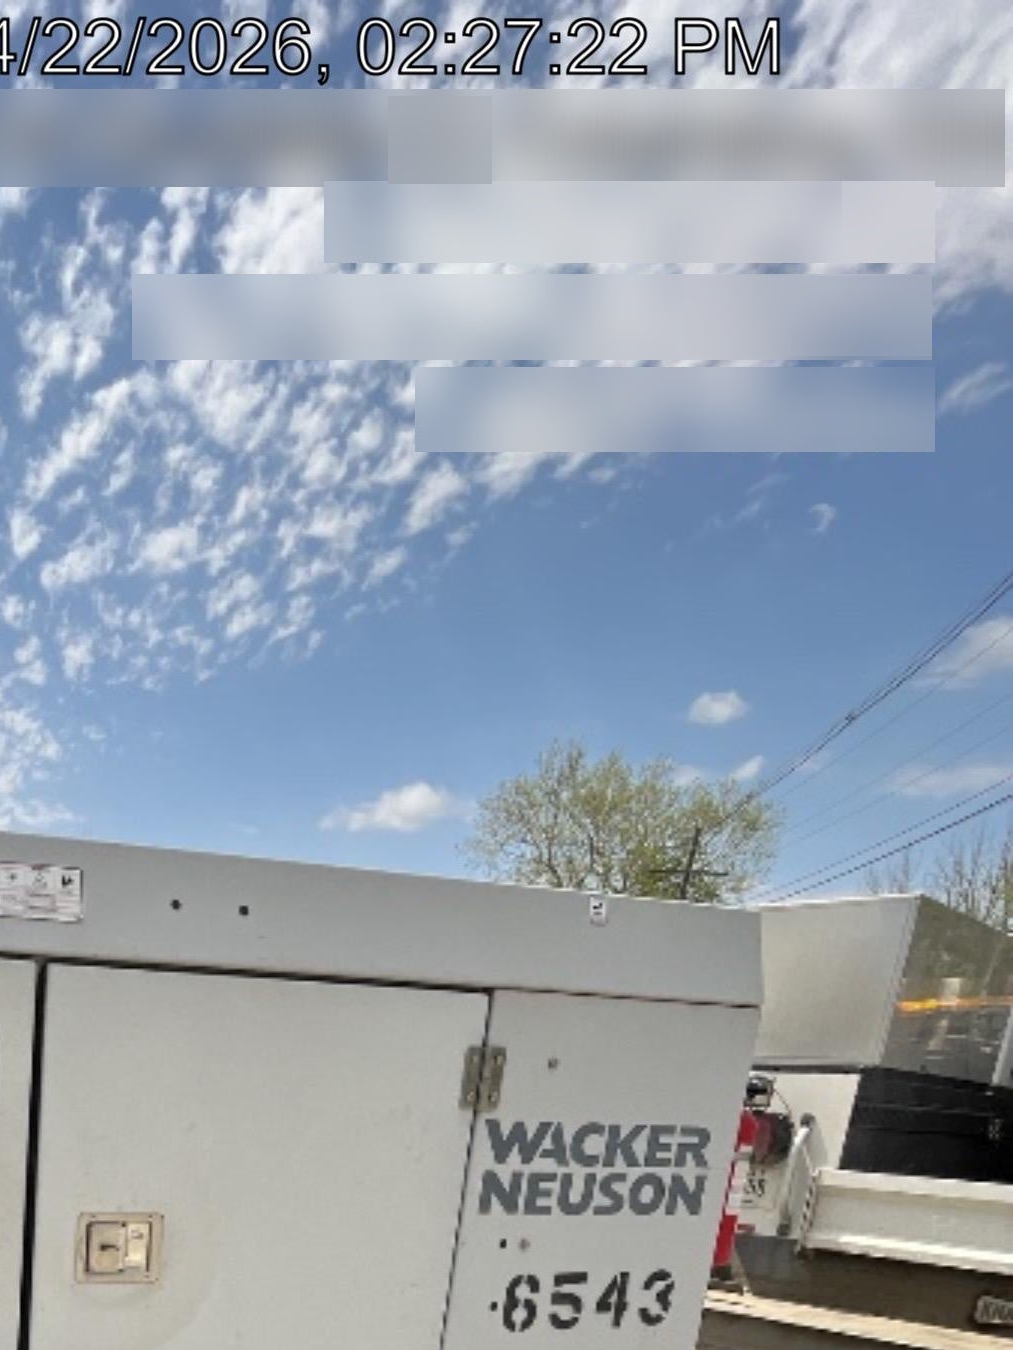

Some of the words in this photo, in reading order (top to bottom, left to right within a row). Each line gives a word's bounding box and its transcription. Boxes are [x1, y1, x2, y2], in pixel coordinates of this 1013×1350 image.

[485, 1118, 711, 1168] WACKER
[478, 1168, 709, 1217] NEUSON
[502, 1268, 675, 1333] 6543
